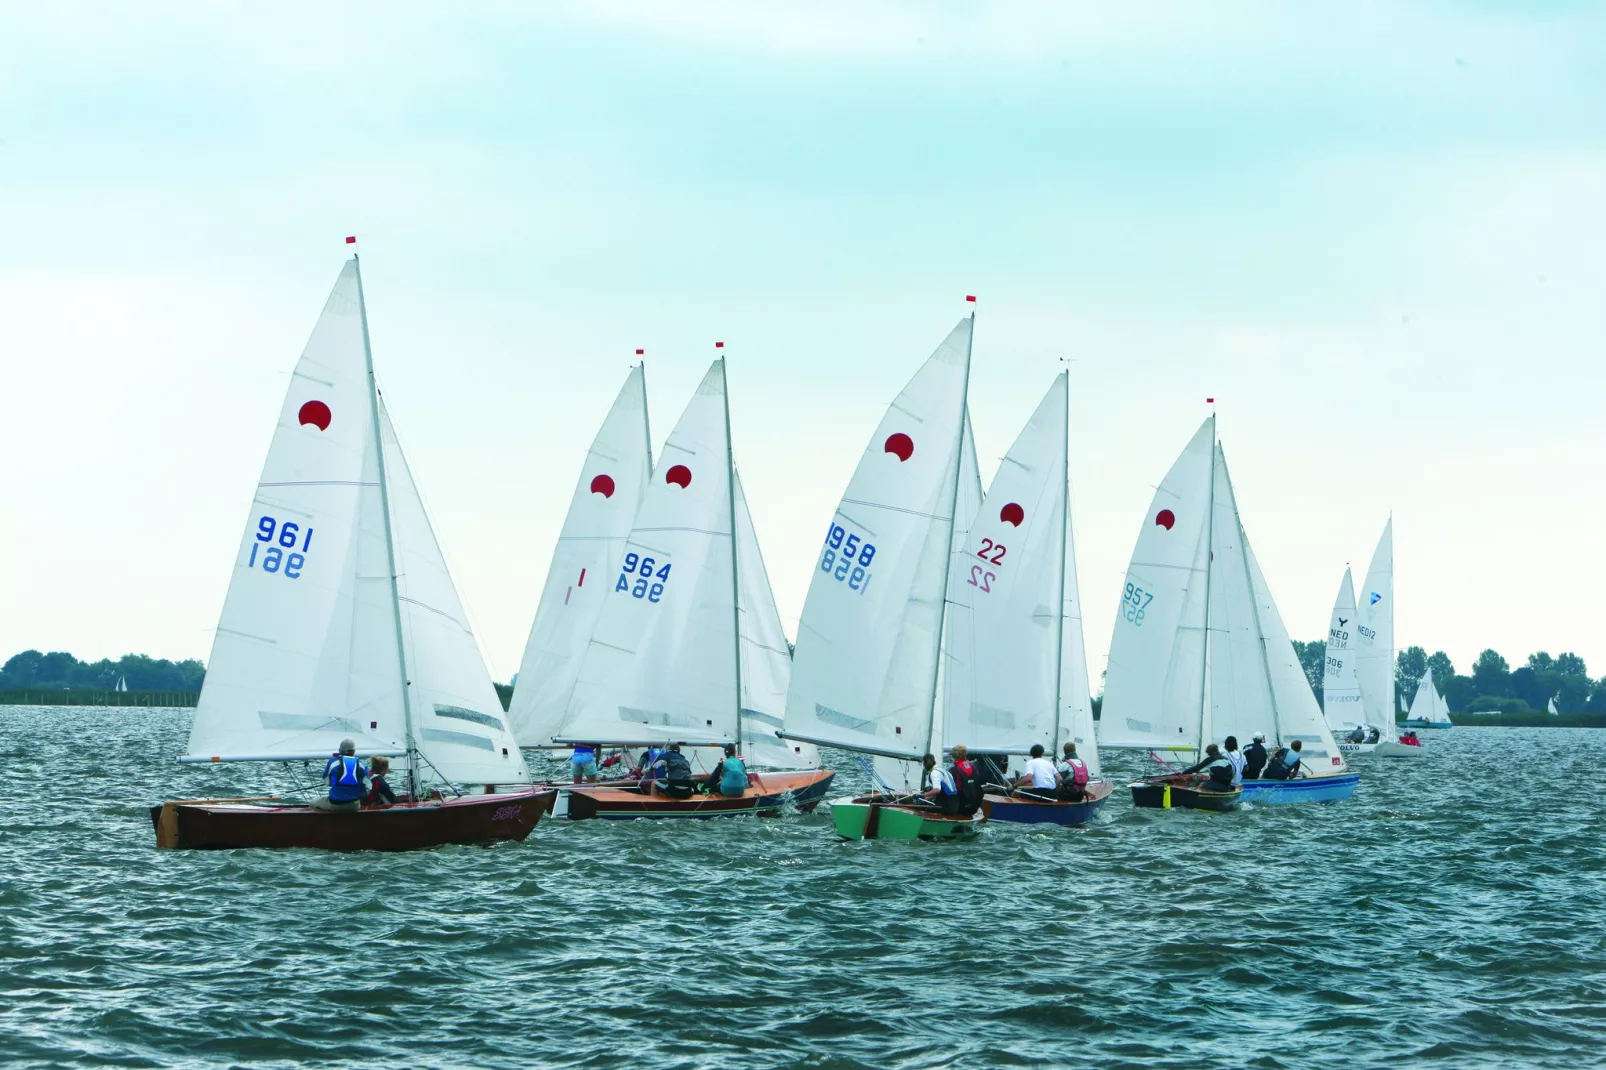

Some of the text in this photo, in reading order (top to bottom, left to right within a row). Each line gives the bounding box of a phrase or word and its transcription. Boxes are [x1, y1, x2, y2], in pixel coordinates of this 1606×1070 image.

[256, 516, 313, 553] 961
[825, 522, 876, 567] 1958
[977, 538, 1007, 566] 22
[623, 553, 672, 582] 964
[1124, 582, 1153, 609] 957
[1330, 629, 1349, 641] NED
[1326, 656, 1343, 669] 306
